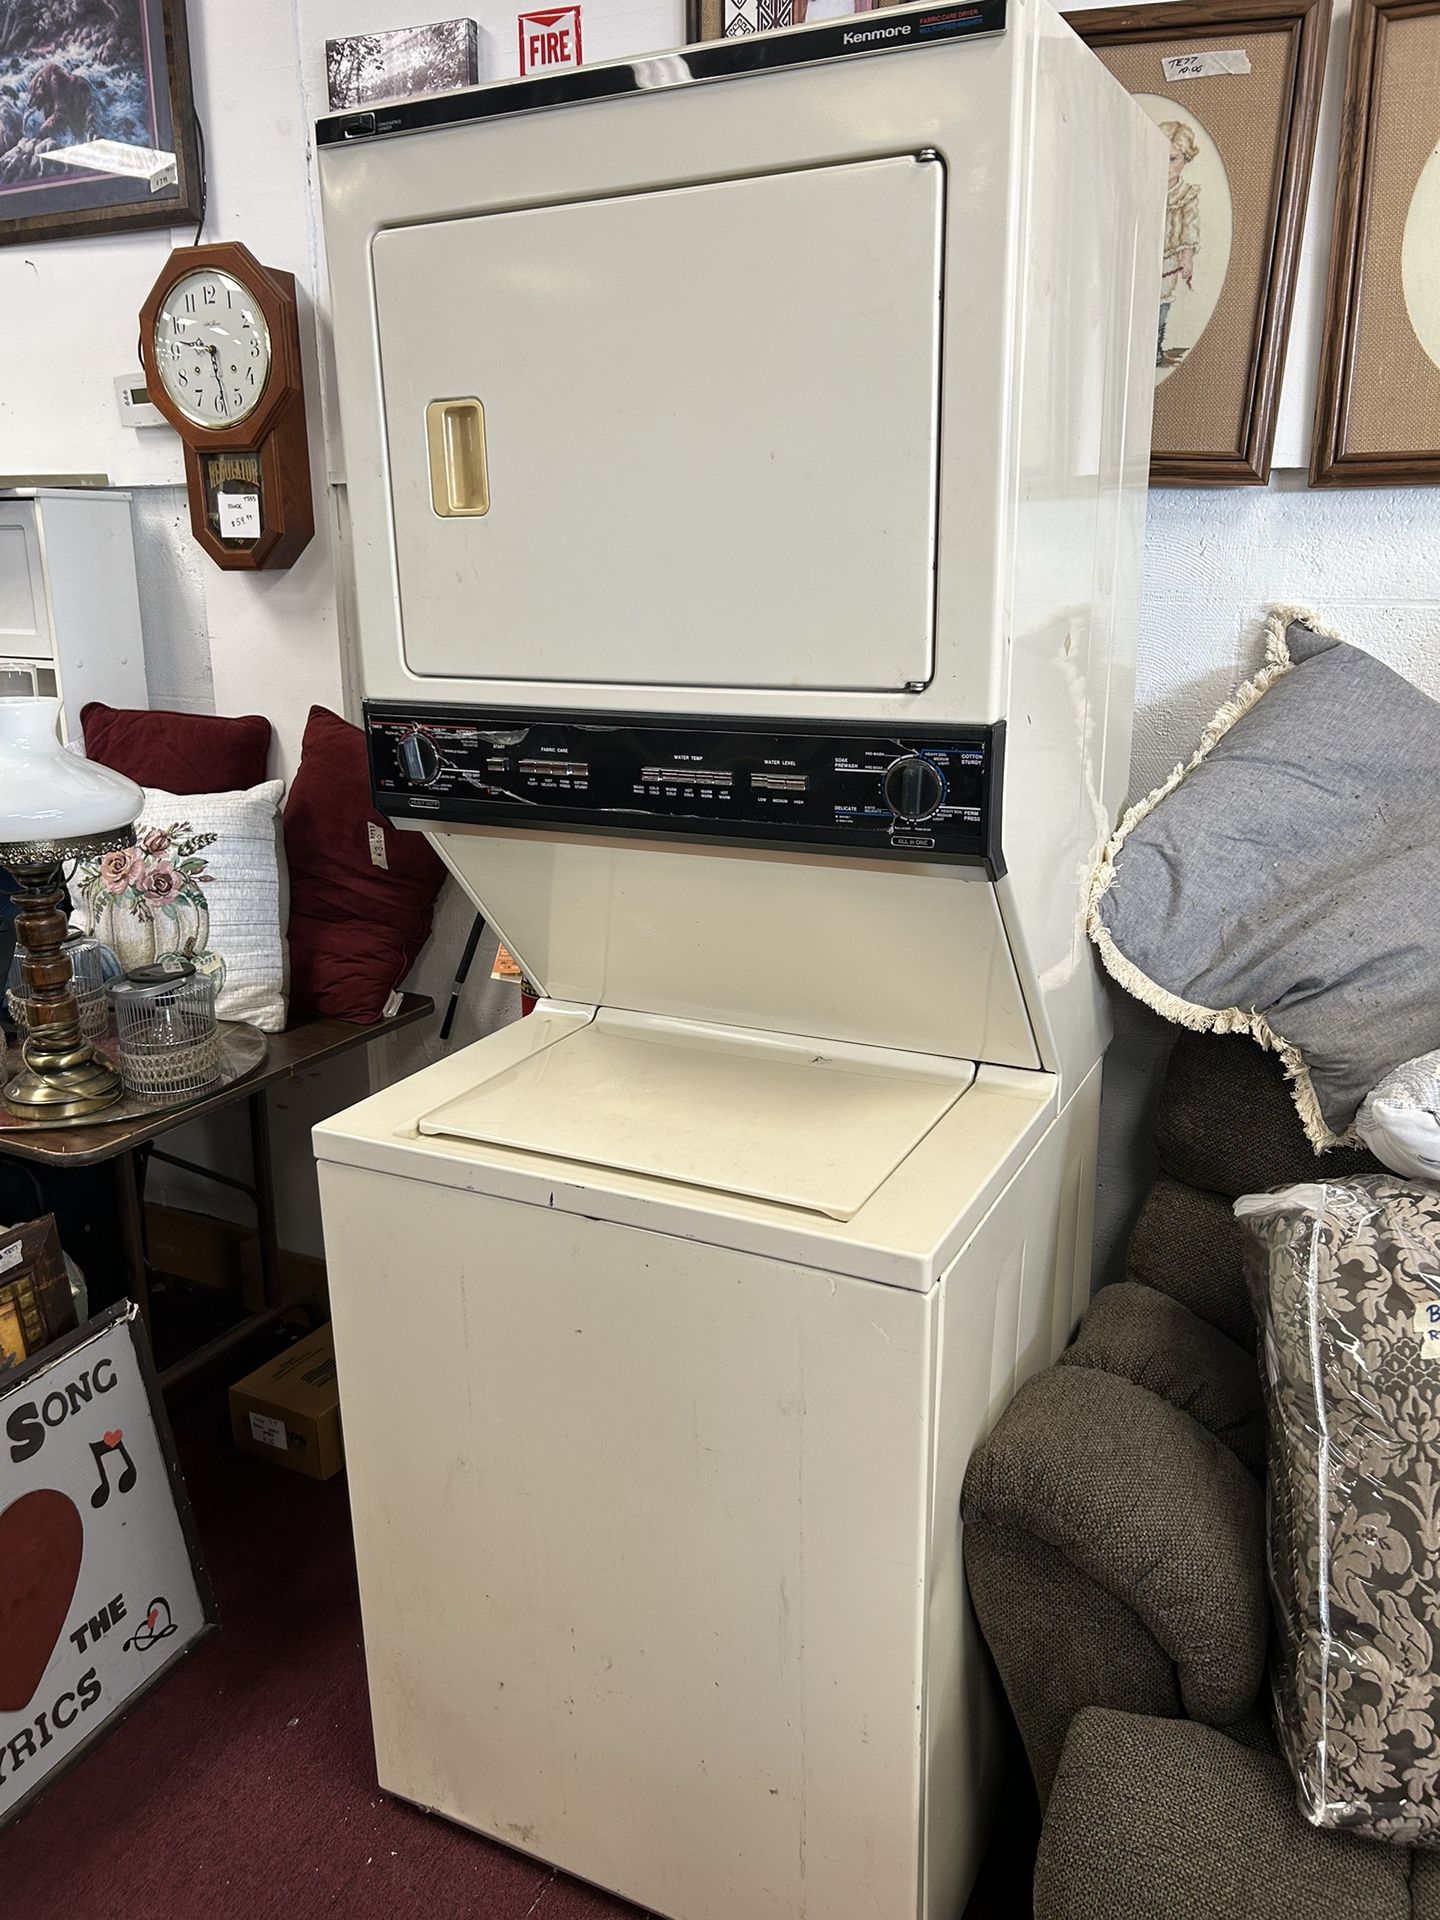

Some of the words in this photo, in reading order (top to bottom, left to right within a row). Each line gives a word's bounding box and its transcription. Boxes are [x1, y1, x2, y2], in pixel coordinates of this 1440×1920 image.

[843, 25, 912, 45] Kenmore
[529, 28, 571, 67] FIRE
[185, 293, 196, 313] 11
[203, 284, 216, 305] 12
[227, 290, 232, 309] 1
[241, 315, 250, 329] 2
[170, 343, 181, 361] 9
[250, 339, 260, 358] 3
[178, 369, 189, 387] 8
[245, 366, 254, 385] 4
[194, 388, 203, 407] 7
[214, 394, 225, 413] 6
[234, 388, 243, 406] 5
[208, 459, 260, 489] REGULATOR
[69, 1593, 127, 1654] THE
